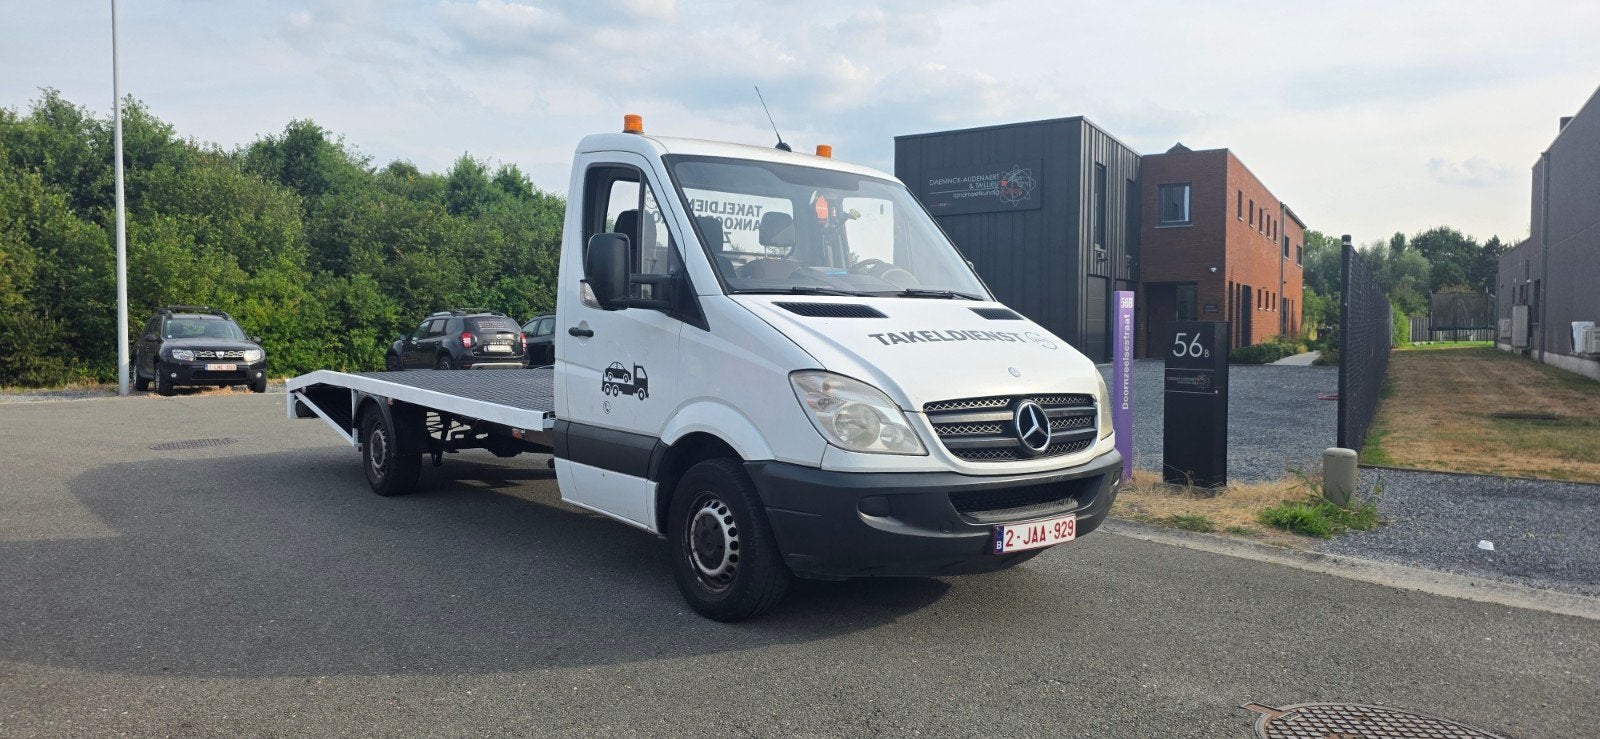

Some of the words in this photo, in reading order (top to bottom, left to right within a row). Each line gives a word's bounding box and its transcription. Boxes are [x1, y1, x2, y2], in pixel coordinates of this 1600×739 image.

[867, 329, 1026, 346] TAKELDIENST
[1172, 332, 1203, 358] 56
[1122, 314, 1130, 410] Doornzeelsestraat
[996, 540, 1003, 550] B
[1005, 519, 1074, 548] 2-JAA-929
